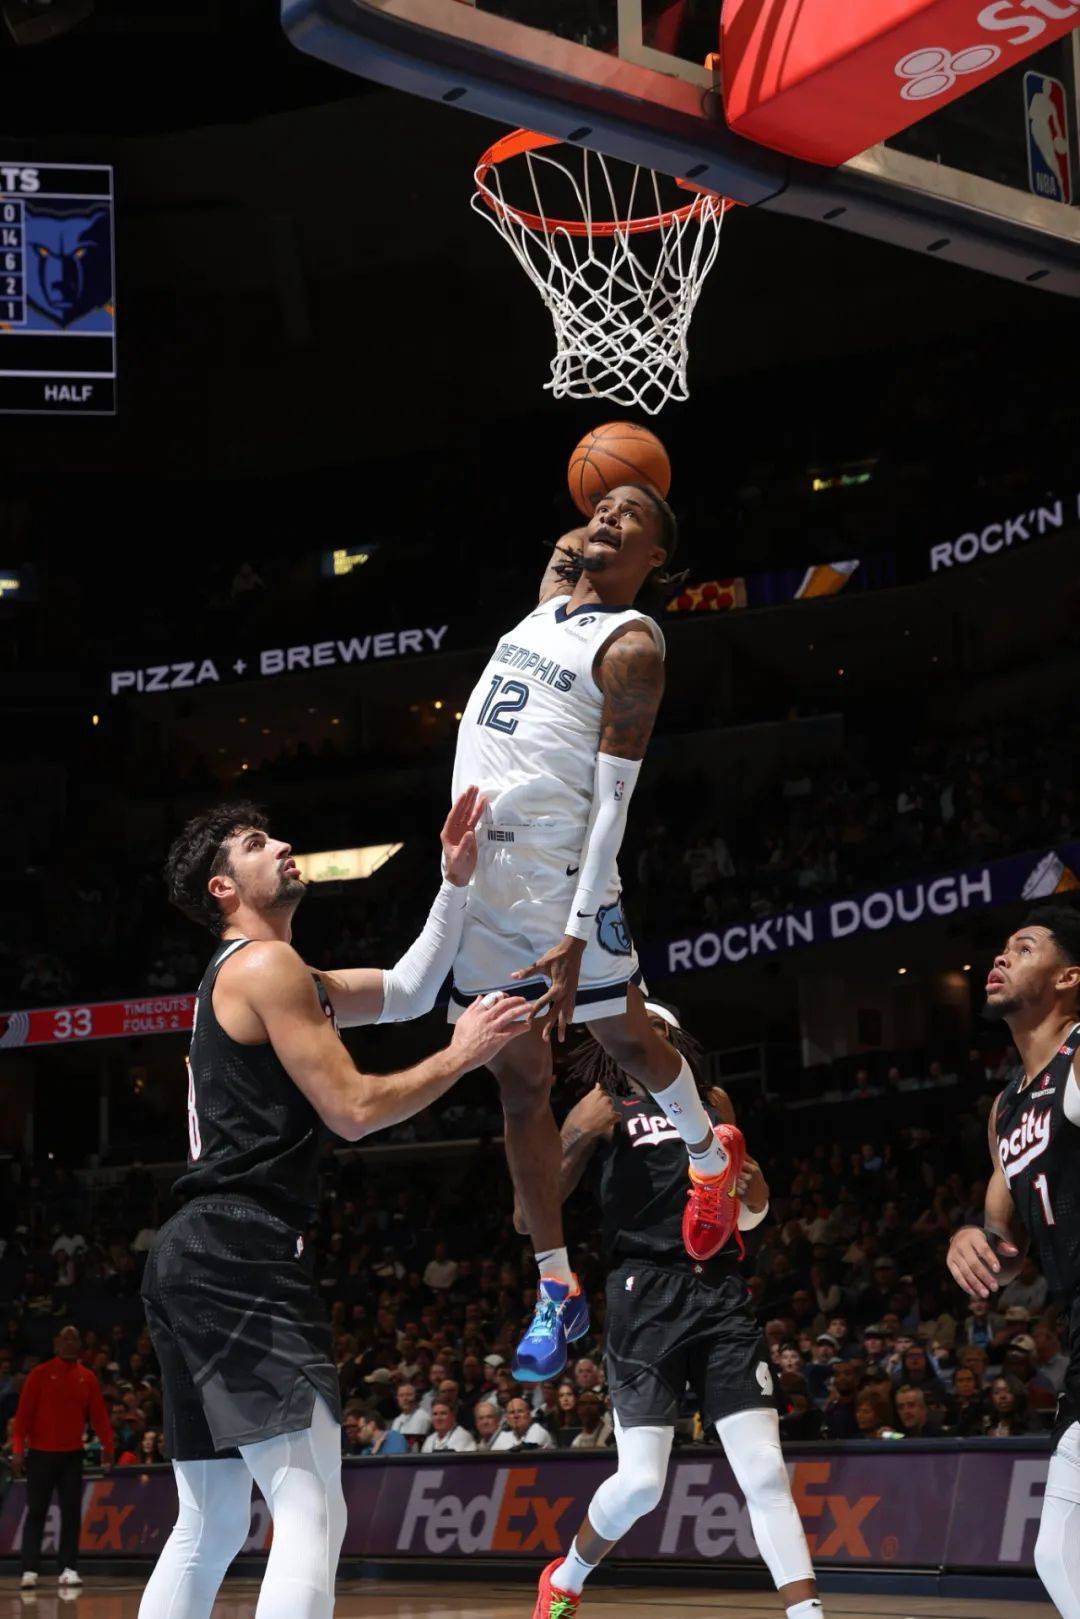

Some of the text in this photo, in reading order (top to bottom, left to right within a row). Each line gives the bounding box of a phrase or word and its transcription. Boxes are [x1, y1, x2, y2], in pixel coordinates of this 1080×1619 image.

[977, 0, 1080, 46] St
[0, 167, 41, 193] TS
[1036, 172, 1058, 196] NBA
[3, 204, 15, 222] 0
[2, 228, 18, 247] 14
[4, 252, 17, 272] 6
[5, 277, 17, 296] 2
[7, 302, 15, 320] 1
[44, 385, 94, 402] HALF
[930, 500, 1063, 573] ROCK'N
[110, 659, 220, 695] PIZZA
[259, 624, 449, 675] BREWERY
[491, 642, 577, 693] MEMPHIS
[476, 673, 530, 736] 12
[668, 868, 993, 973] ROCK'N DOUGH
[52, 1008, 93, 1038] 33
[626, 1112, 677, 1142] rip
[1034, 1172, 1056, 1225] 1
[396, 1467, 576, 1554] FedEx
